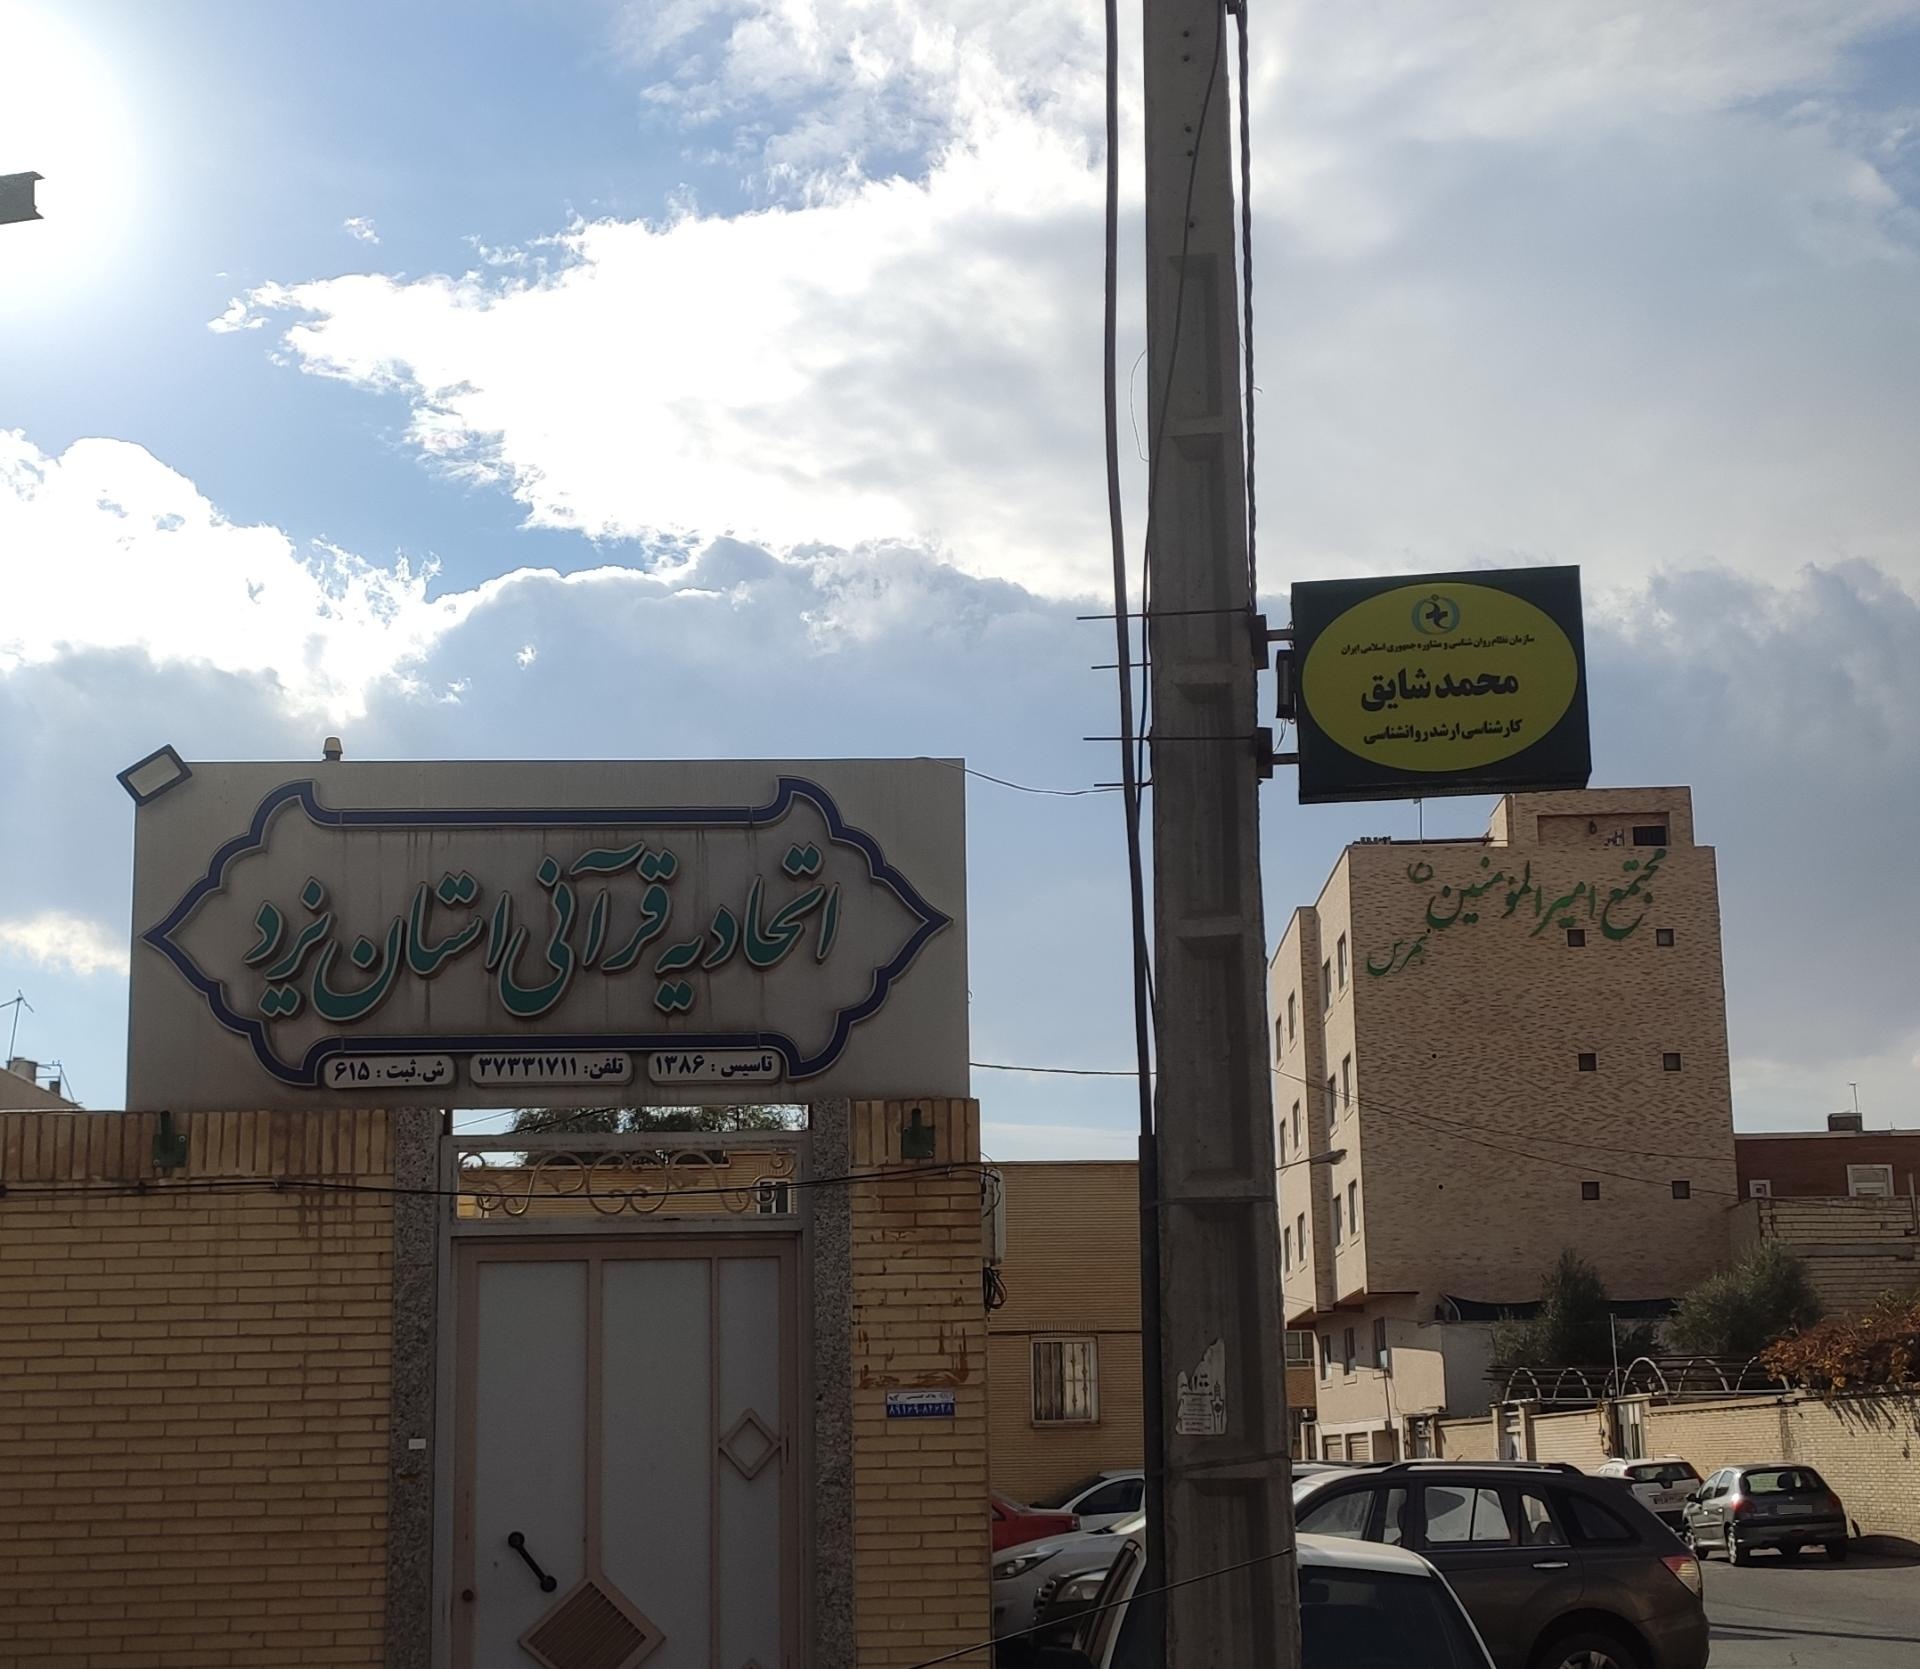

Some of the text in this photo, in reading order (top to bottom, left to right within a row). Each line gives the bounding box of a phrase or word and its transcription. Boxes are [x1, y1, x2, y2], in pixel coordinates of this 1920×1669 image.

[1341, 645, 1360, 655] ایران
[1361, 643, 1386, 655] اسلامی
[1386, 642, 1417, 653] جمهوری
[1417, 640, 1443, 652] مشاوره
[1491, 636, 1508, 646] نظام
[1509, 634, 1535, 646] سازمان
[1361, 668, 1519, 712] محمد شایق
[1363, 718, 1523, 744] کارشناسی ارشد روانشناسی
[1602, 848, 1666, 940] مجتمع
[241, 841, 840, 1021] اتحادیه قرآنی استان یزد
[334, 1061, 370, 1081] ۶۱۵
[478, 1056, 577, 1077] ۳۷۳۳۱۷۱۱
[655, 1055, 705, 1075] ۱۳۸۶
